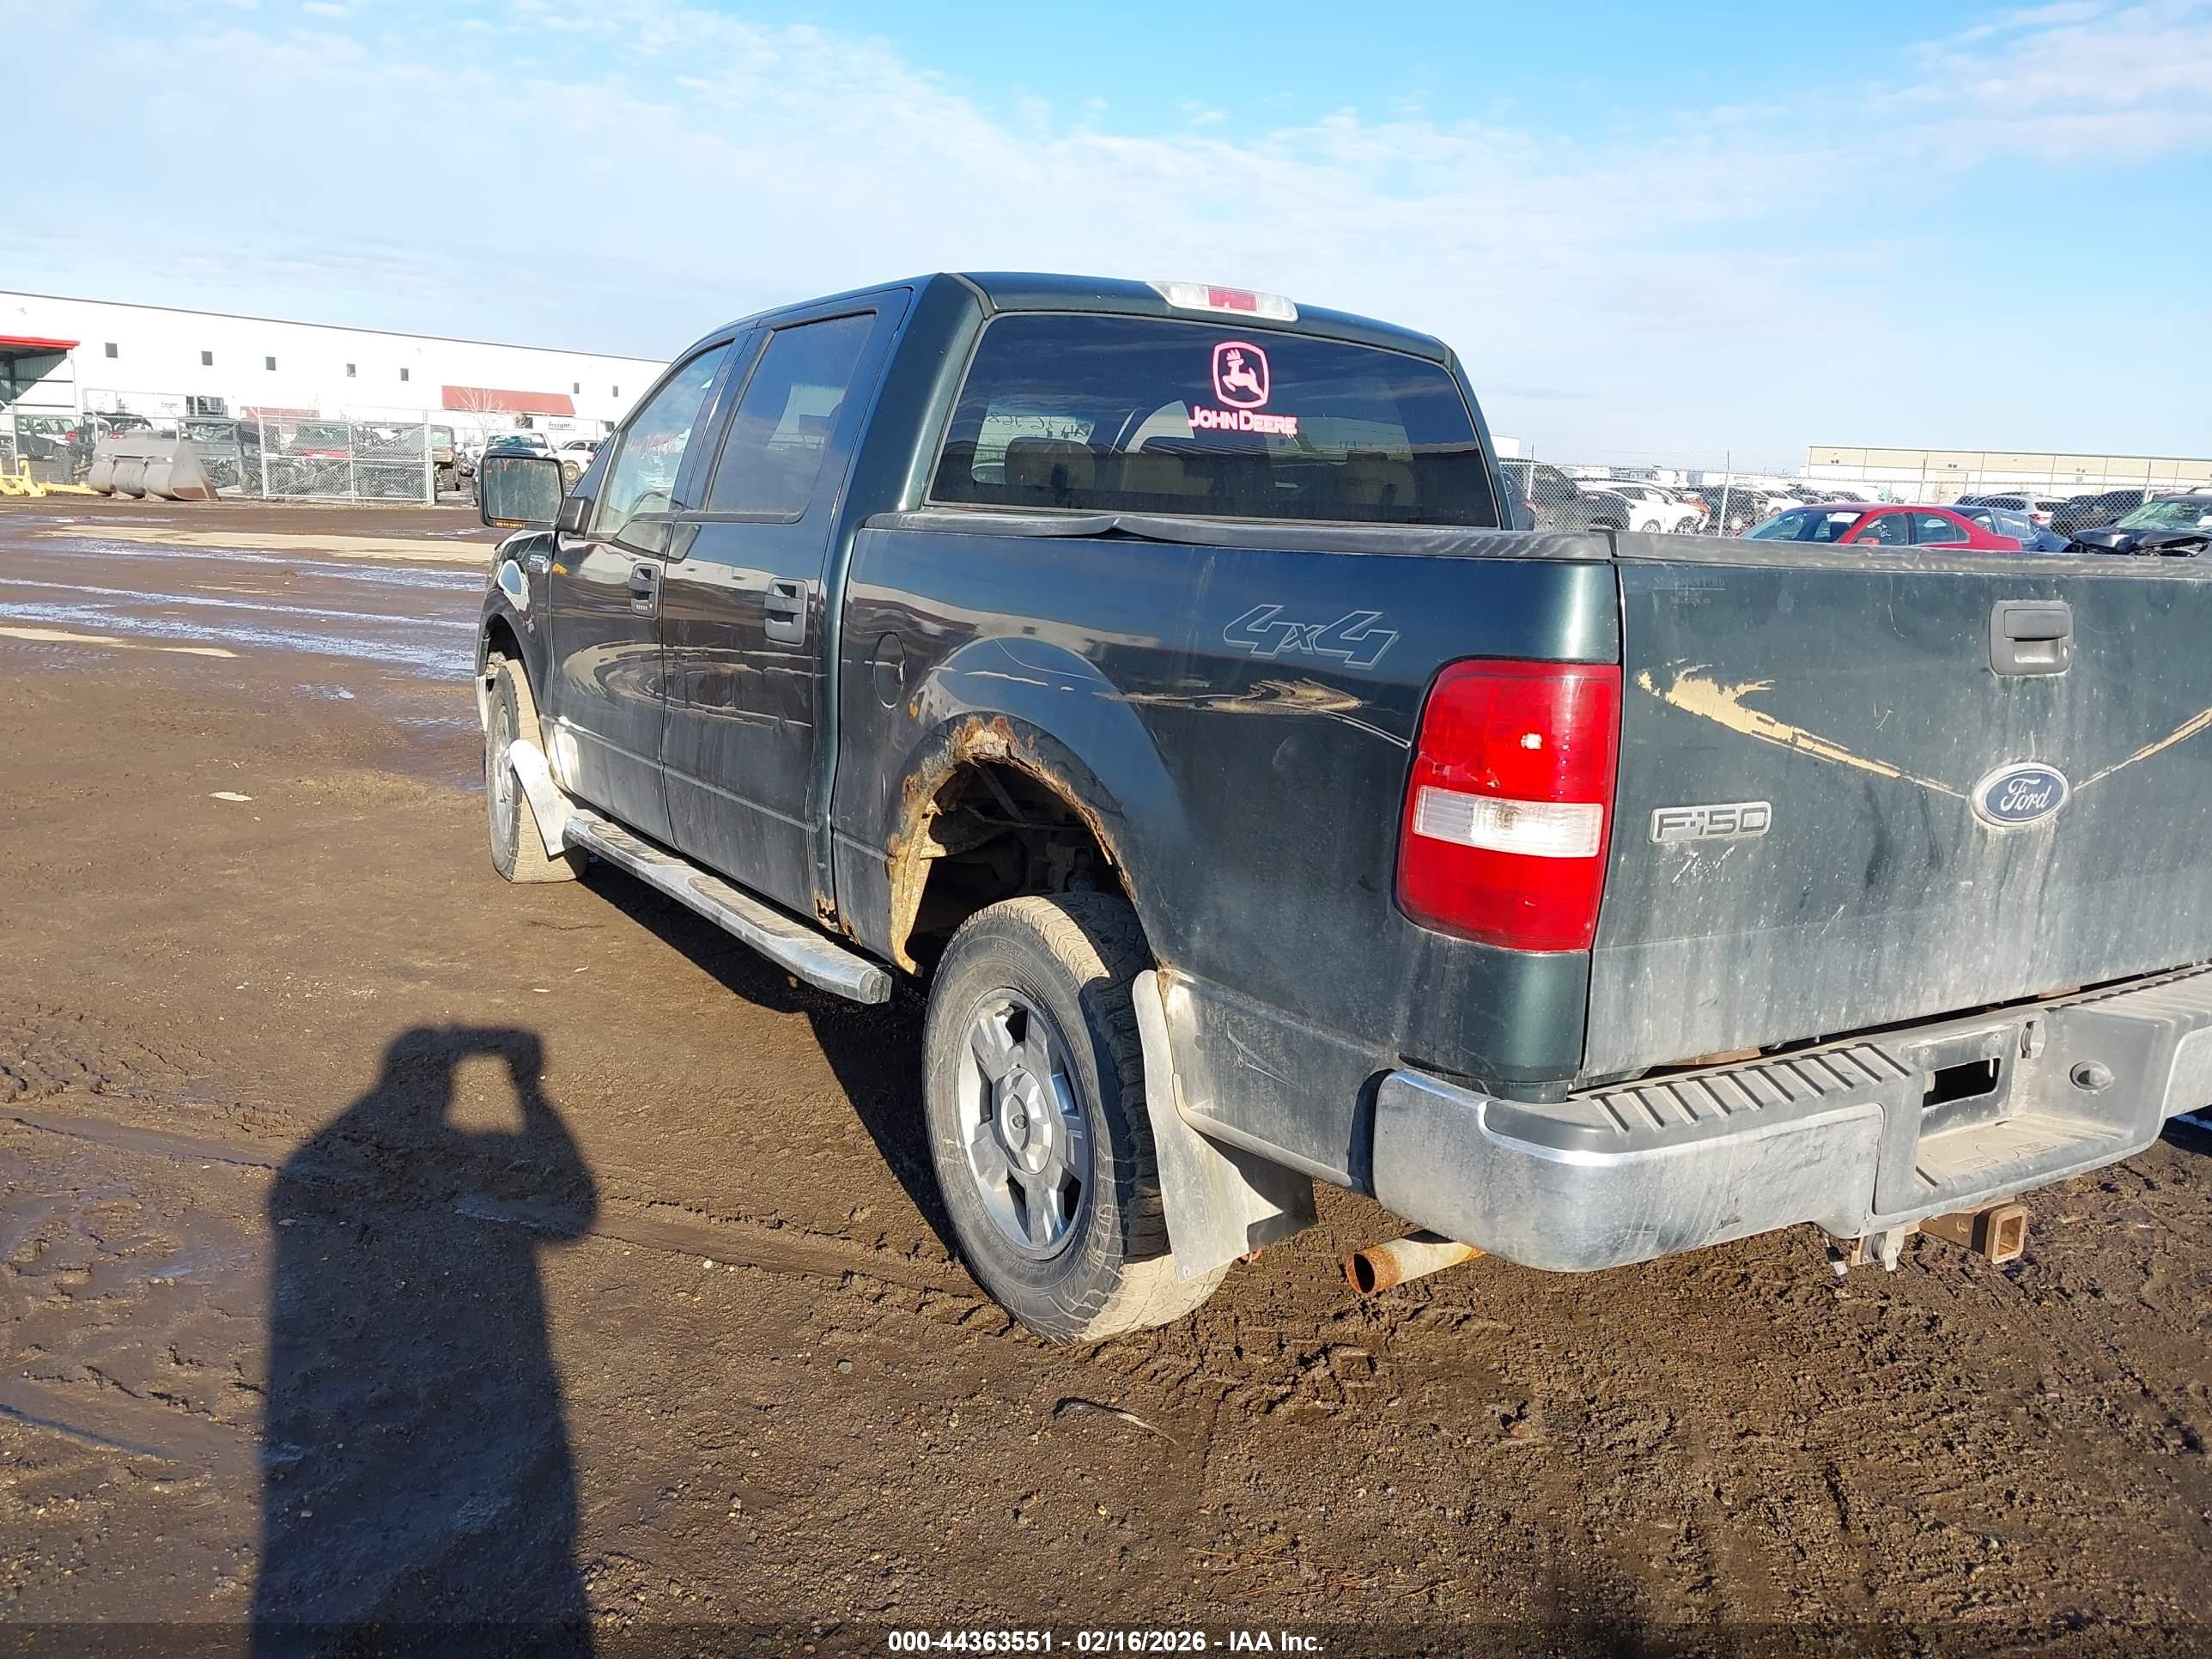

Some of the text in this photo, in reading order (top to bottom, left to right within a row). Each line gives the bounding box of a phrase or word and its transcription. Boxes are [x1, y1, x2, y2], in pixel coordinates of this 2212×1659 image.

[1188, 404, 1297, 434] JOHN DEERE
[1224, 604, 1399, 666] 4x4
[2000, 777, 2052, 811] Ford
